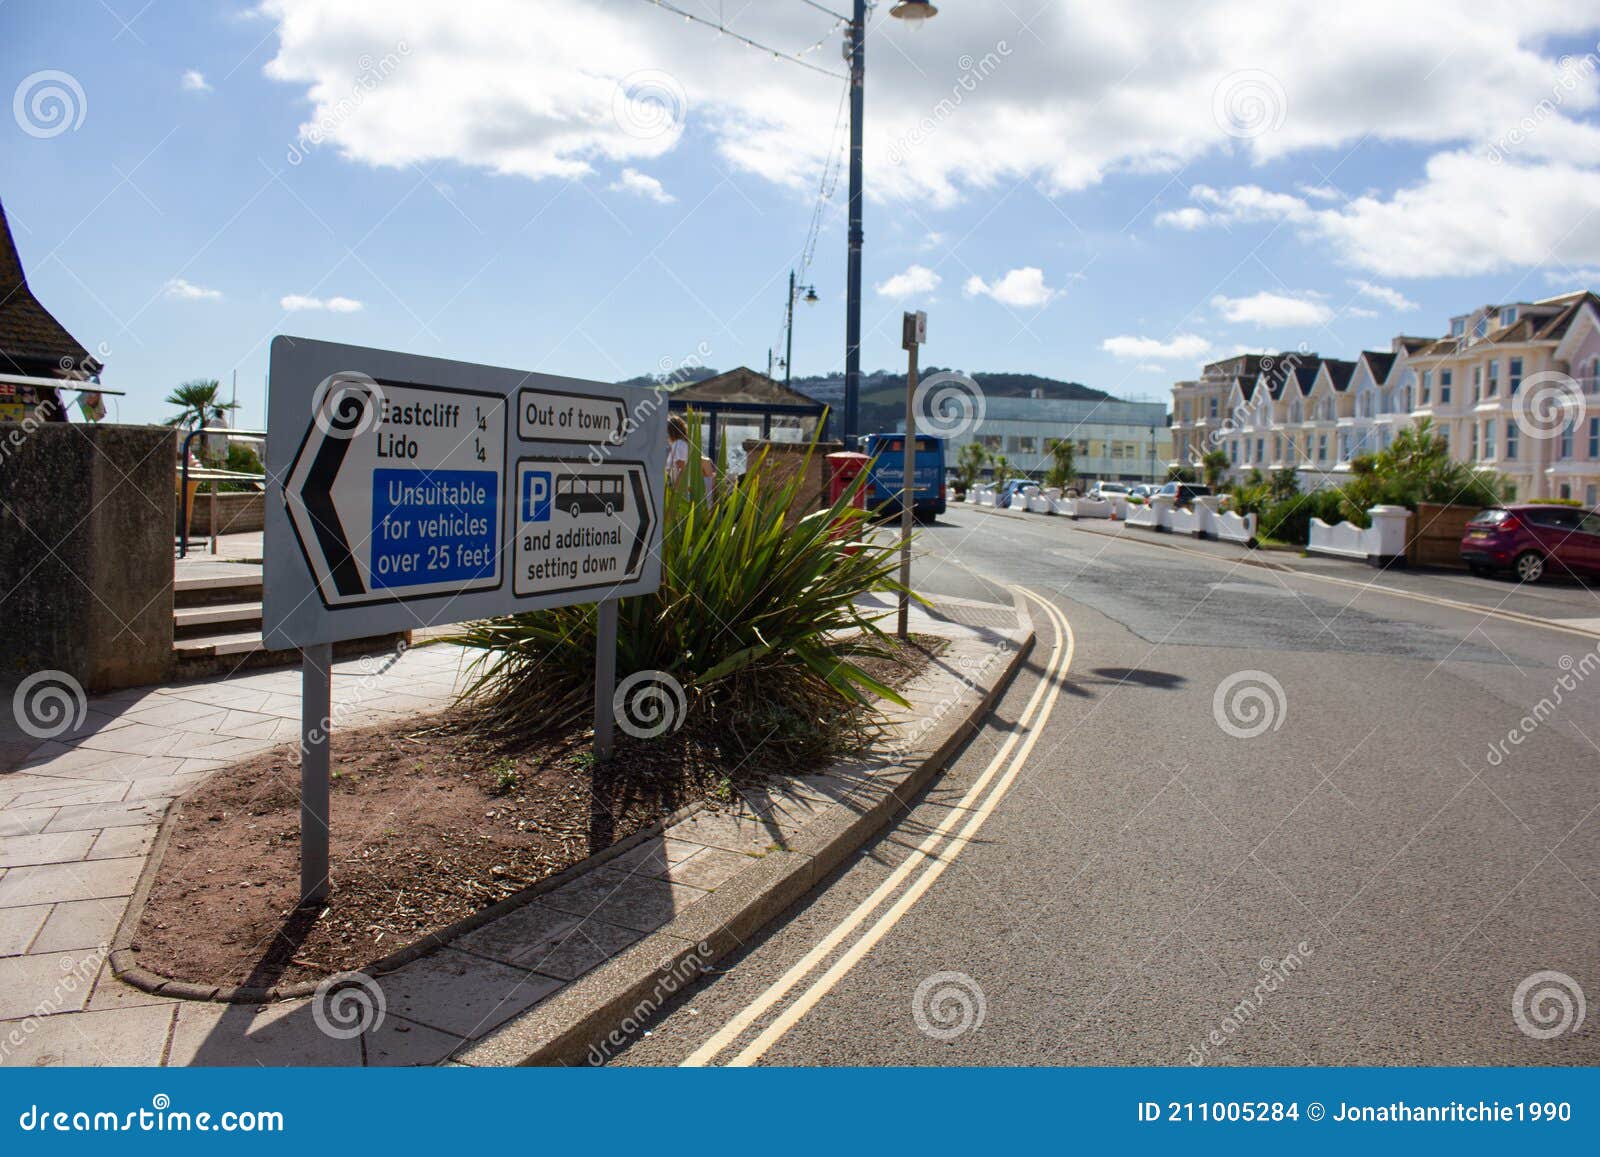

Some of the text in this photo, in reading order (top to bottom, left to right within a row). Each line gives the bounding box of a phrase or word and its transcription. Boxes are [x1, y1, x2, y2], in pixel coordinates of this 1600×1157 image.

[379, 397, 460, 428] Eastcliff
[526, 403, 611, 430] Out of town
[377, 432, 418, 459] Lido
[388, 480, 486, 507] Unsuitable
[529, 476, 548, 517] P
[383, 512, 488, 540] for vehicles
[523, 525, 622, 552] and additional
[378, 543, 491, 575] over 25 feet
[528, 554, 617, 581] setting down
